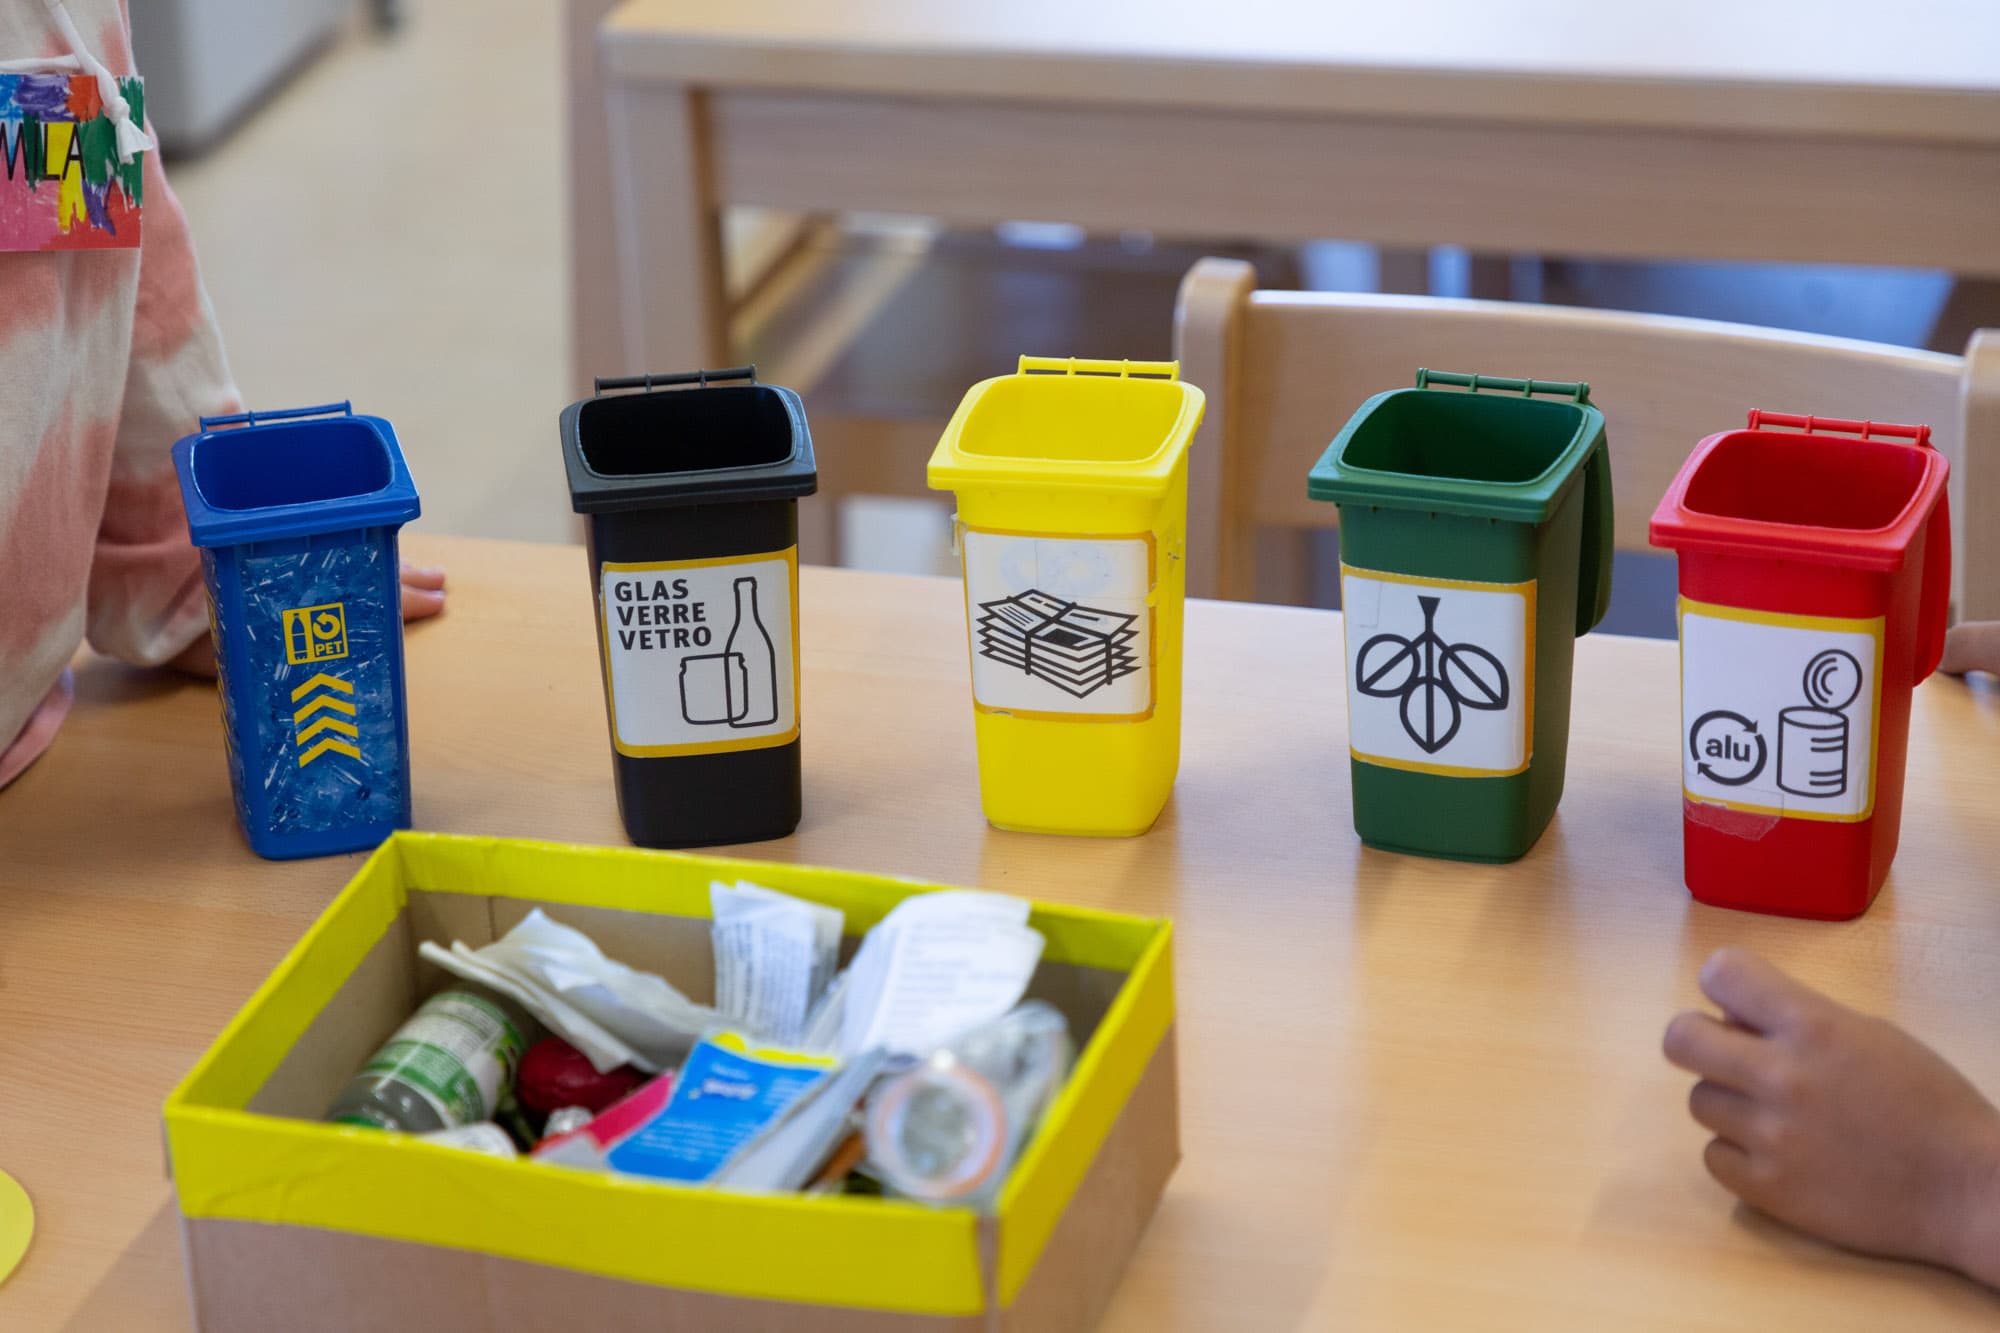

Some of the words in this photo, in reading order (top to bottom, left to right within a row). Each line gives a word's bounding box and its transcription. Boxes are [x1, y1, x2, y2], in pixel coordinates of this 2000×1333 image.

[614, 578, 689, 602] GLAS
[616, 602, 706, 626] VERRE
[315, 640, 343, 656] PET
[618, 626, 712, 650] VETRO
[1705, 735, 1750, 762] alu
